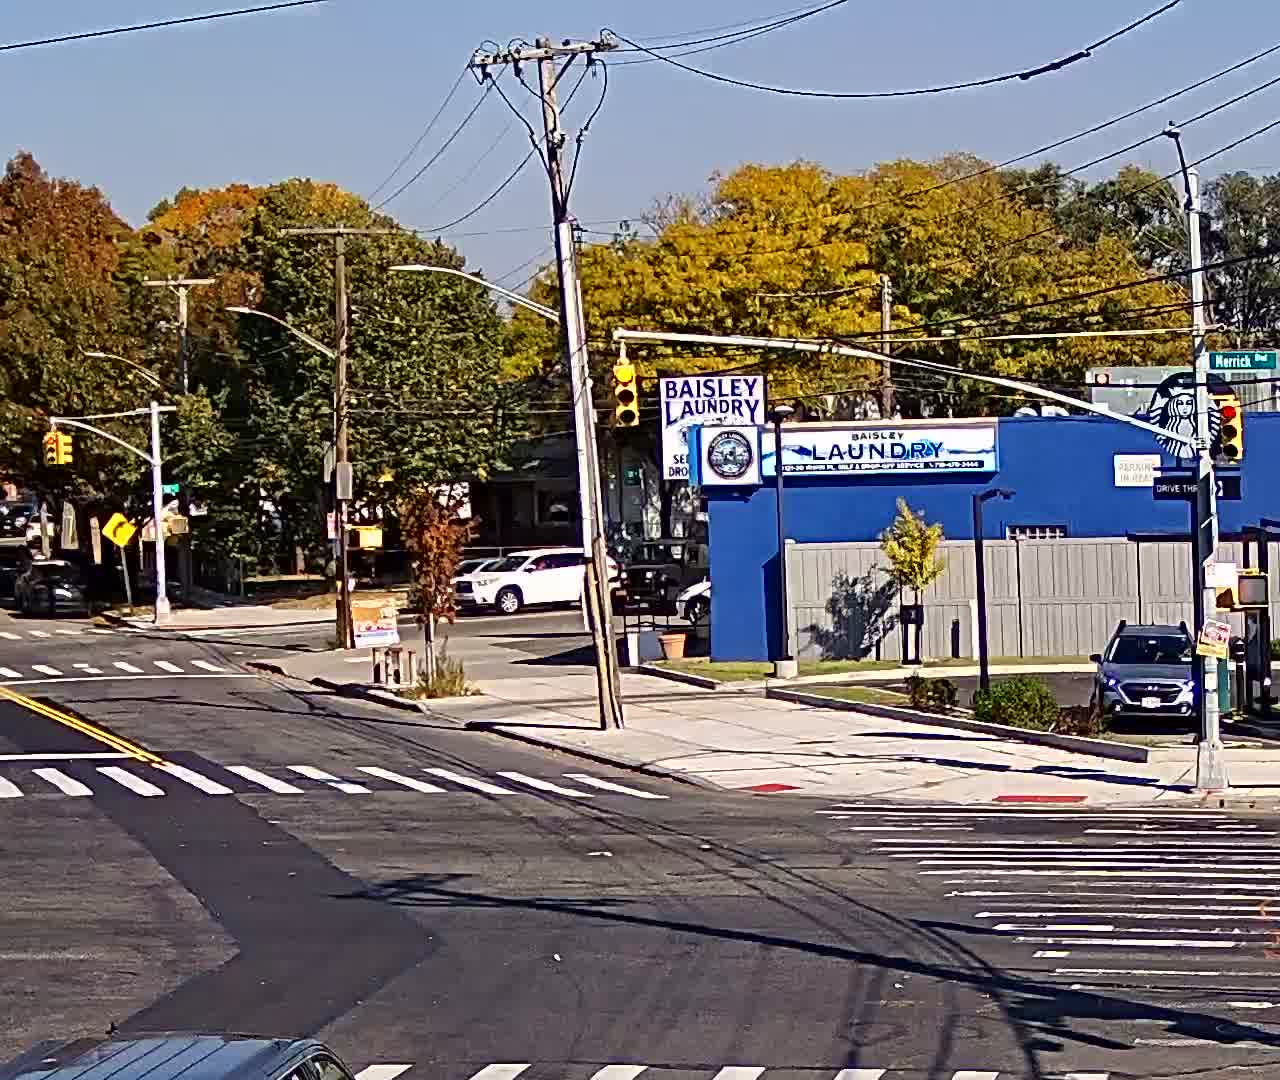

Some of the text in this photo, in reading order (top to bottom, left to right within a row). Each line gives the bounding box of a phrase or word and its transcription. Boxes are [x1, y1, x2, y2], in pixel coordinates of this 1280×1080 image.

[1215, 354, 1252, 368] Merrick
[665, 378, 758, 399] BAISLEY
[665, 399, 760, 429] LAUNDRY
[852, 431, 904, 440] BAISLEY
[812, 441, 943, 460] LAUNDRY
[1156, 484, 1180, 493] DRIVE
